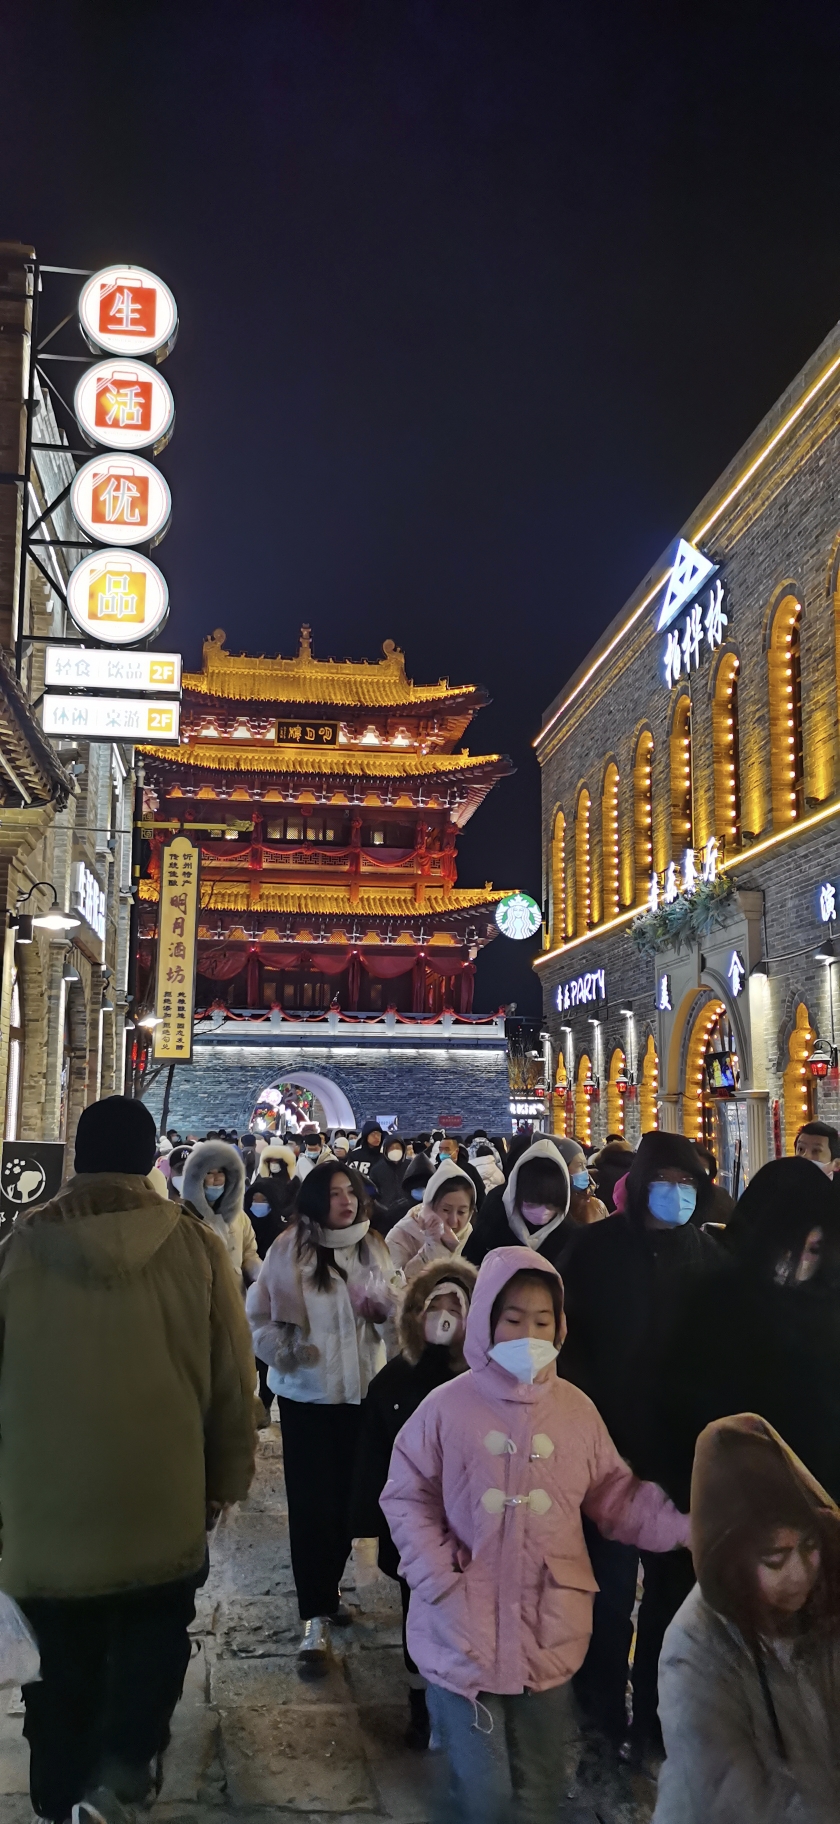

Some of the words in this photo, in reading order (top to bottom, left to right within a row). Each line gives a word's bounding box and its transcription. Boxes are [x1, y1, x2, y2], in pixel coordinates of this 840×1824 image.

[55, 657, 91, 677] 轻食
[107, 660, 143, 680] 饮品
[151, 665, 174, 680] 2F
[52, 706, 89, 726] 休闲
[150, 713, 172, 728] 2F
[182, 853, 193, 887] 忻州特产
[166, 892, 188, 984] 明月酒坊
